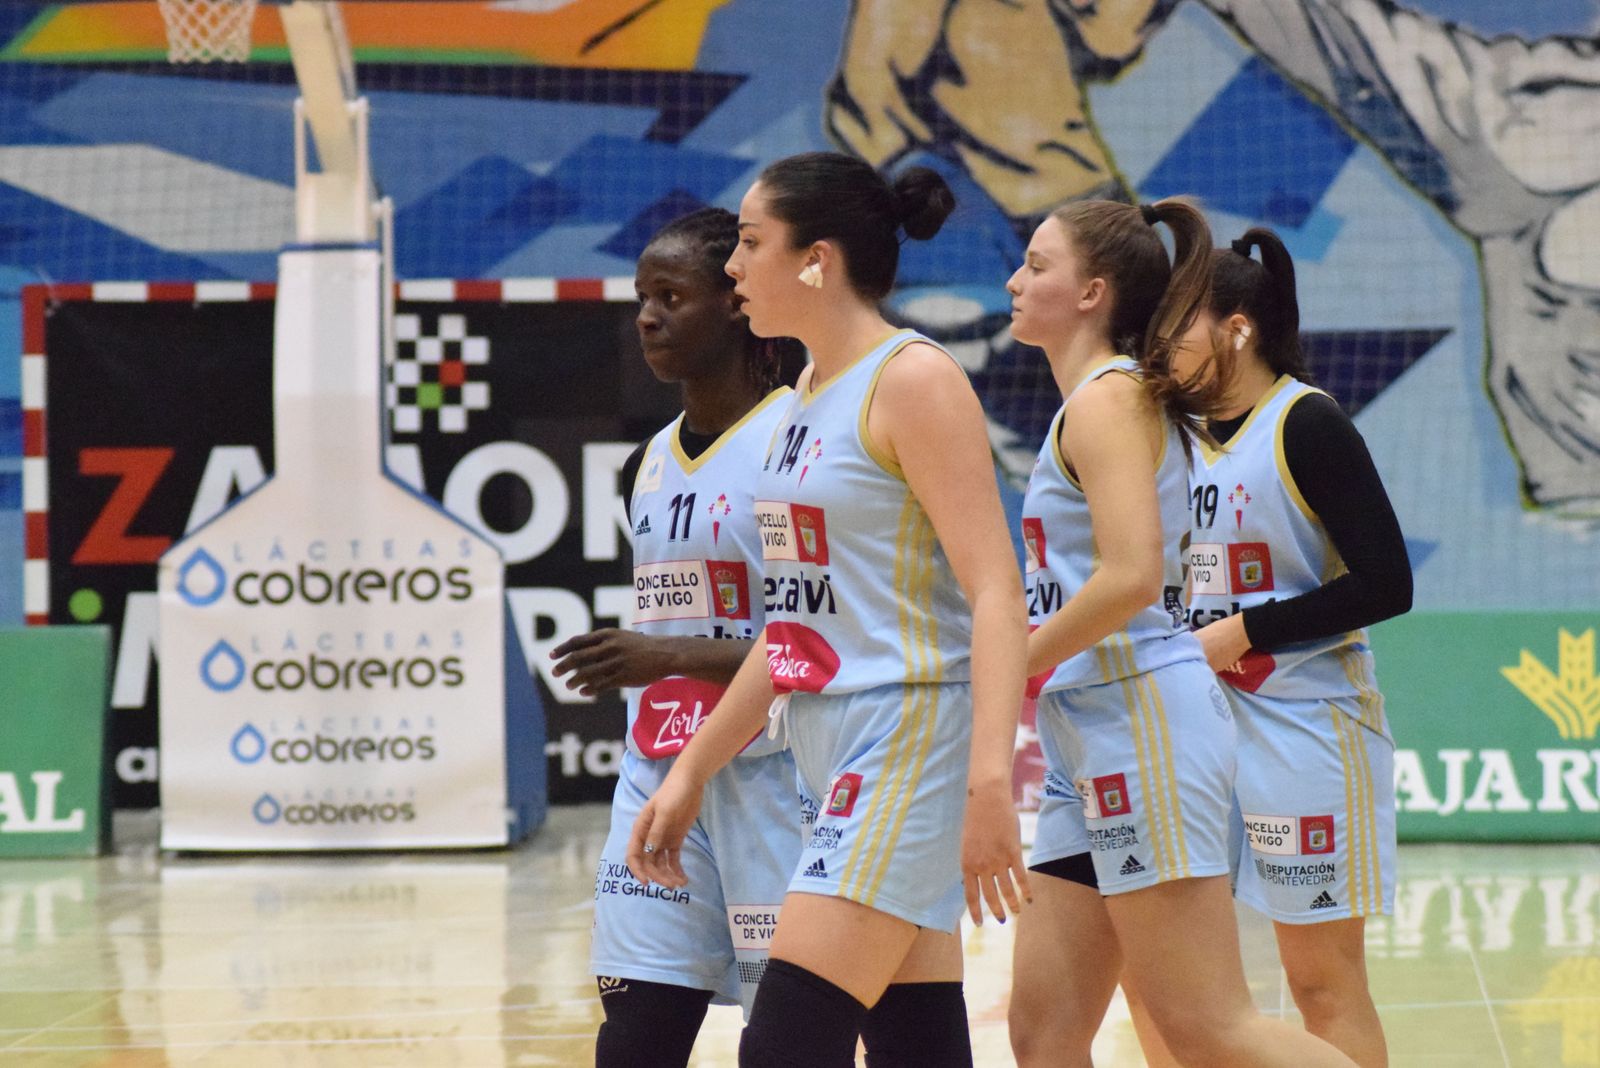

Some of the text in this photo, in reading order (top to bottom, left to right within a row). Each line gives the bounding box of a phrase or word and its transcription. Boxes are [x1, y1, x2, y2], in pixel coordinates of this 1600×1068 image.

[776, 424, 809, 475] 14
[1192, 484, 1219, 529] 19
[668, 492, 696, 542] 11
[764, 532, 787, 546] VIGO
[233, 563, 474, 605] cobreros
[638, 591, 692, 609] DE VIGO
[251, 653, 465, 692] cobreros
[270, 733, 437, 764] cobreros
[282, 801, 417, 824] cobreros
[1255, 834, 1283, 847] VIGO
[803, 870, 829, 878] adidas
[1120, 865, 1146, 875] adidas
[1266, 861, 1335, 876] DEPUTACIÓN
[1267, 873, 1336, 886] PONTEVEDRA
[602, 880, 690, 904] DE GALICIA
[1310, 901, 1338, 910] adidas
[743, 928, 756, 939] DE
